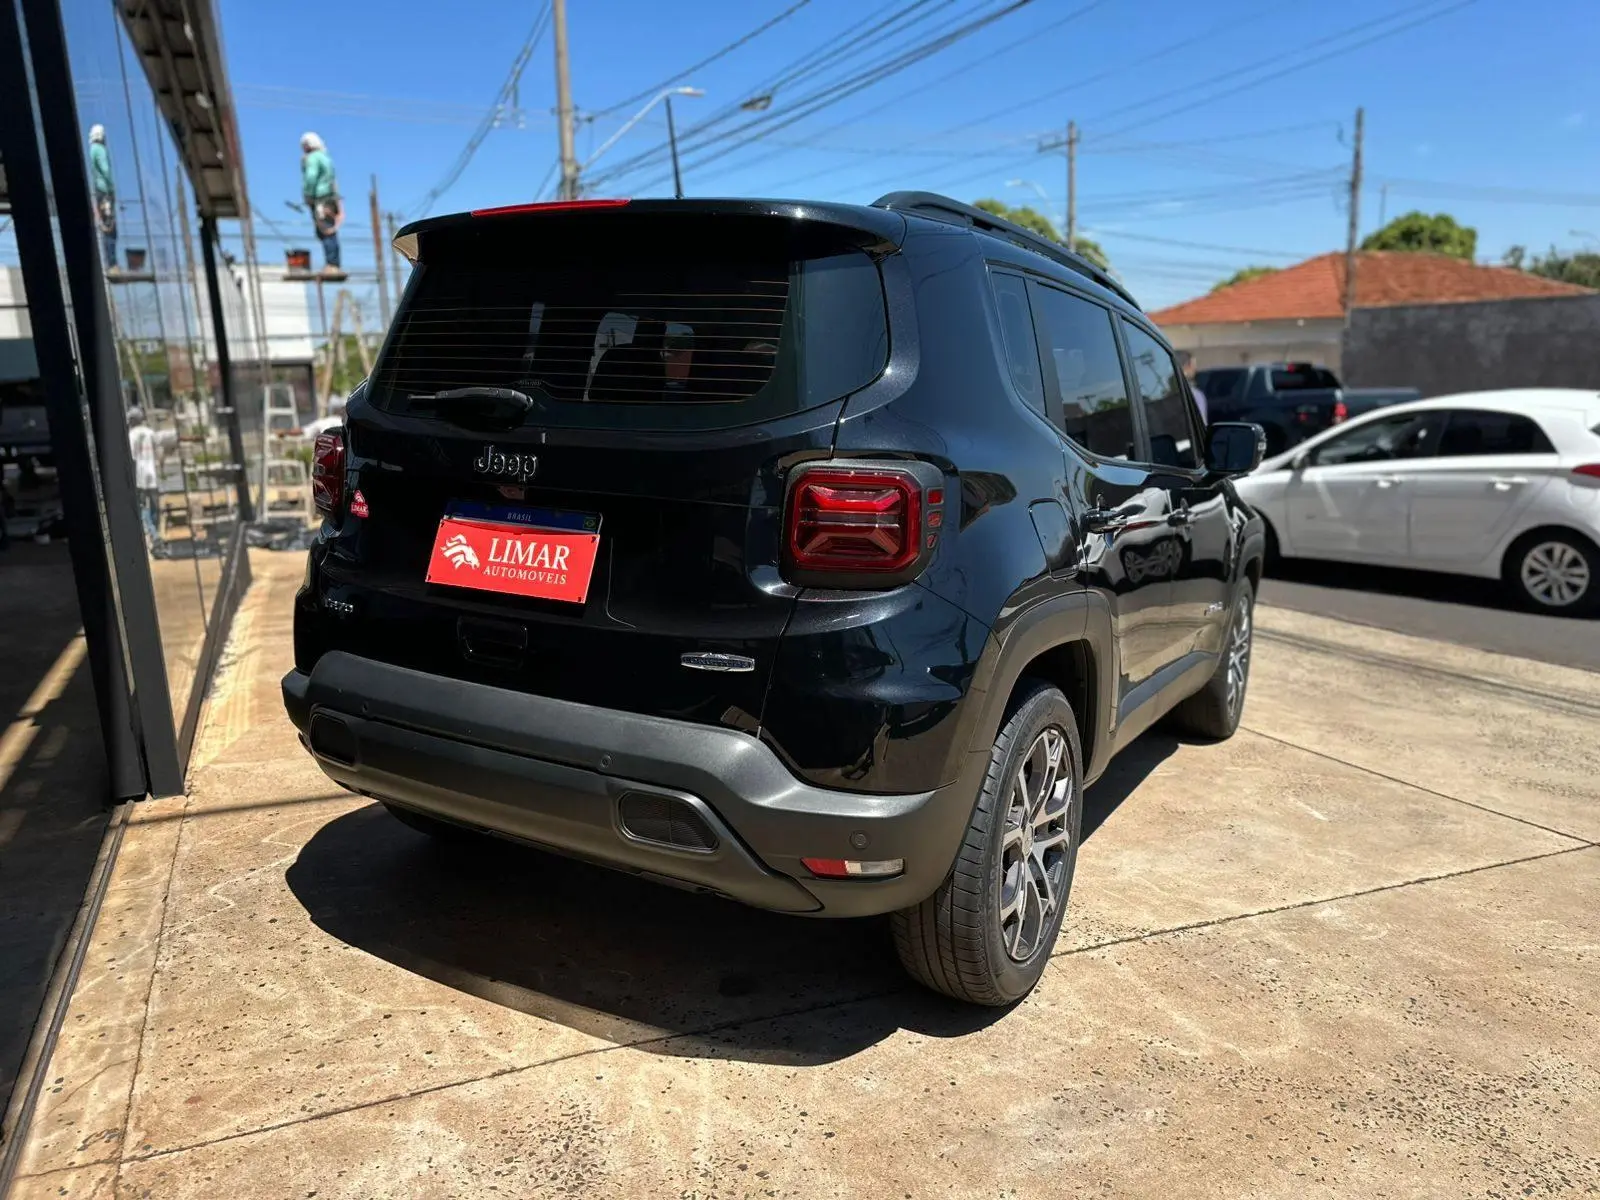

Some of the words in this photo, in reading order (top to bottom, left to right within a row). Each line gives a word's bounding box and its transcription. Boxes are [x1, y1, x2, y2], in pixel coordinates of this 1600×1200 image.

[473, 445, 539, 482] Jeep
[507, 512, 532, 522] BRASIL
[488, 537, 571, 571] LIMAR
[484, 565, 567, 585] AUTOMOVEIS
